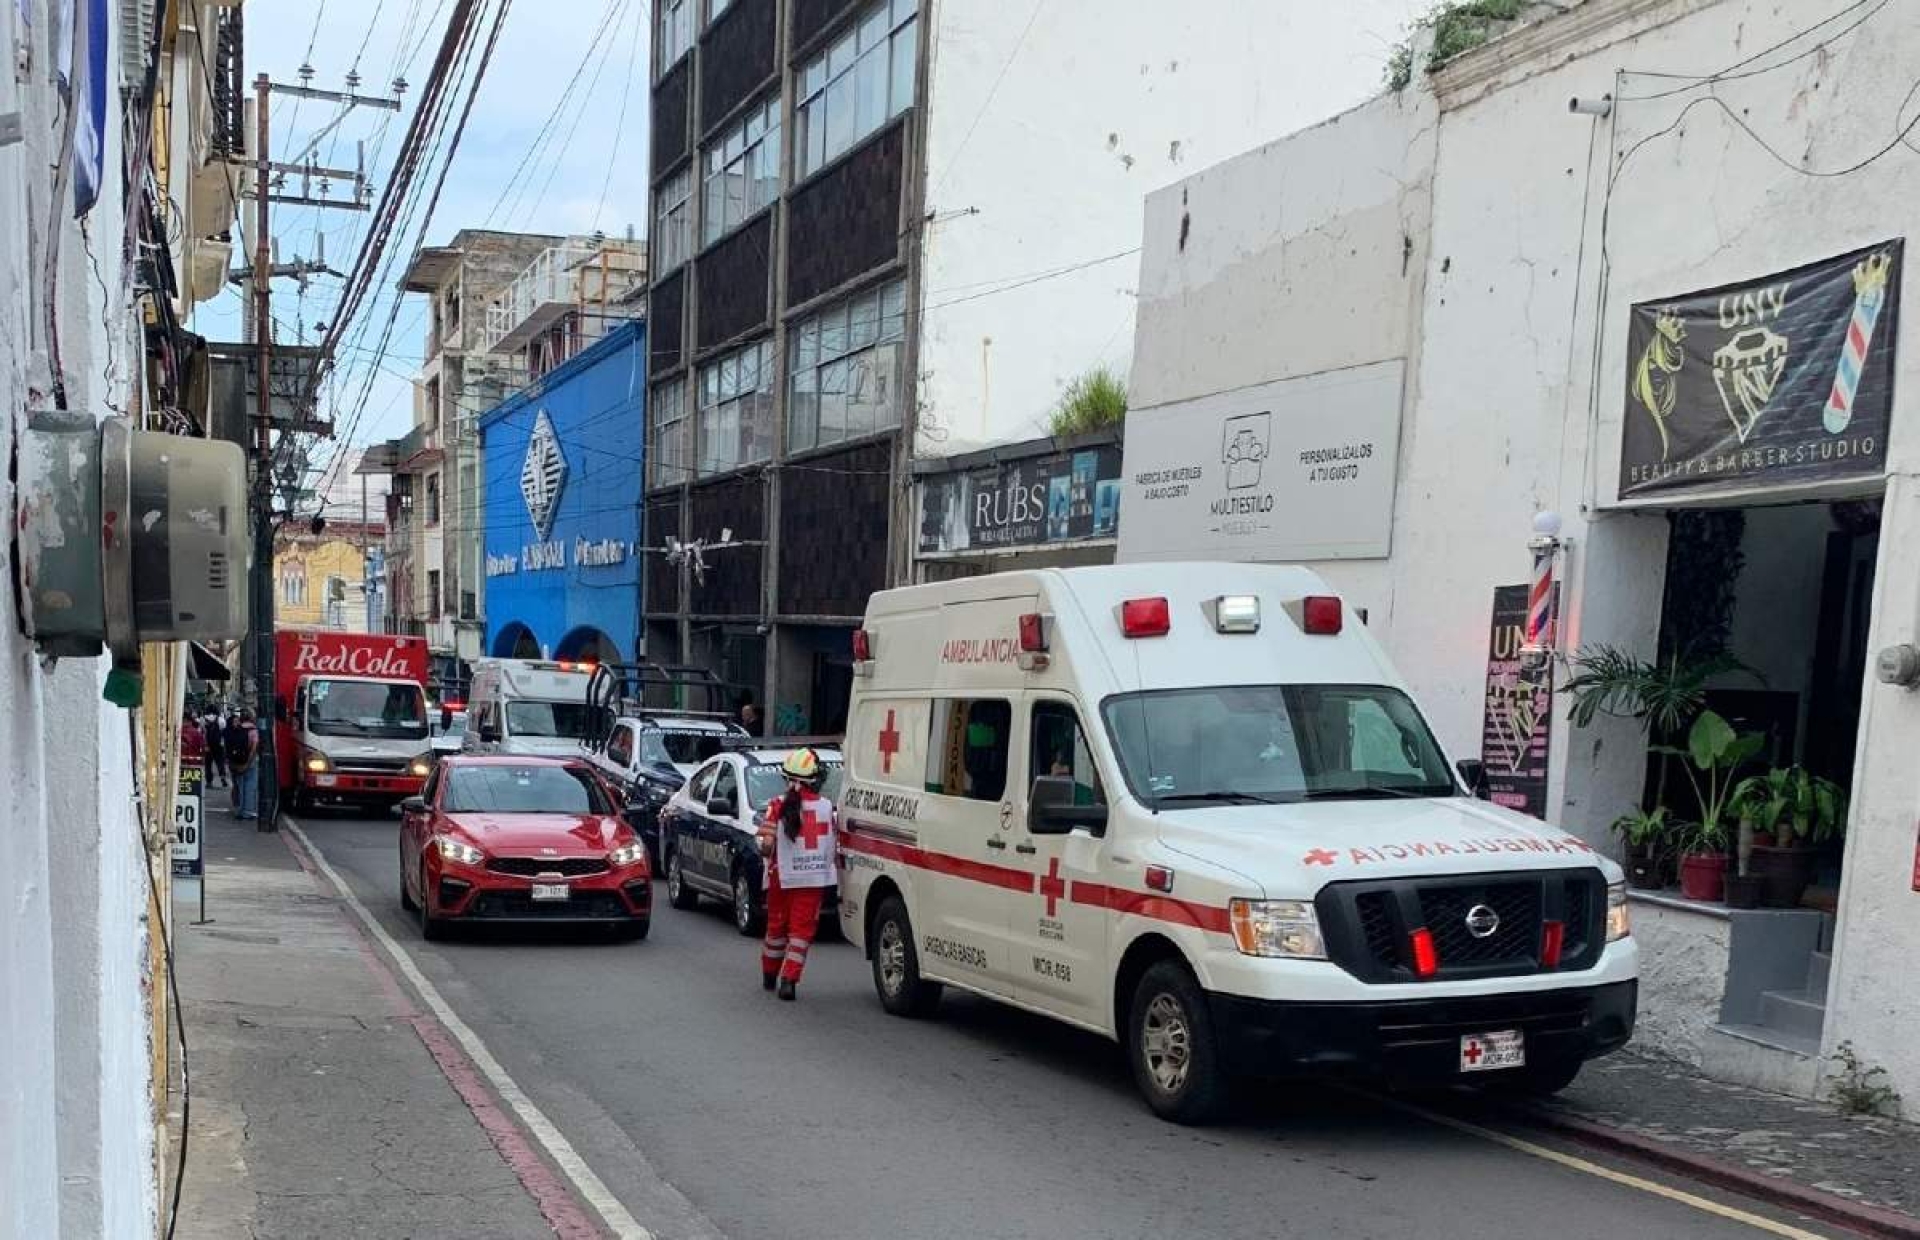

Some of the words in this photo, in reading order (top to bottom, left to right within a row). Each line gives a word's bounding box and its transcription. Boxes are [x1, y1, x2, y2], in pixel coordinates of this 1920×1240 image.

[1329, 463, 1358, 481] GUSTO
[1631, 459, 1694, 483] BEAUTY
[1698, 457, 1708, 474] &
[1716, 448, 1788, 473] BARBER
[1796, 436, 1876, 462] STUDIO
[975, 483, 1046, 527] RUBS
[942, 637, 1021, 664] AMBULANCIA
[844, 786, 861, 809] CRUZ
[863, 789, 881, 812] ROJA
[881, 793, 919, 820] MEXICANA
